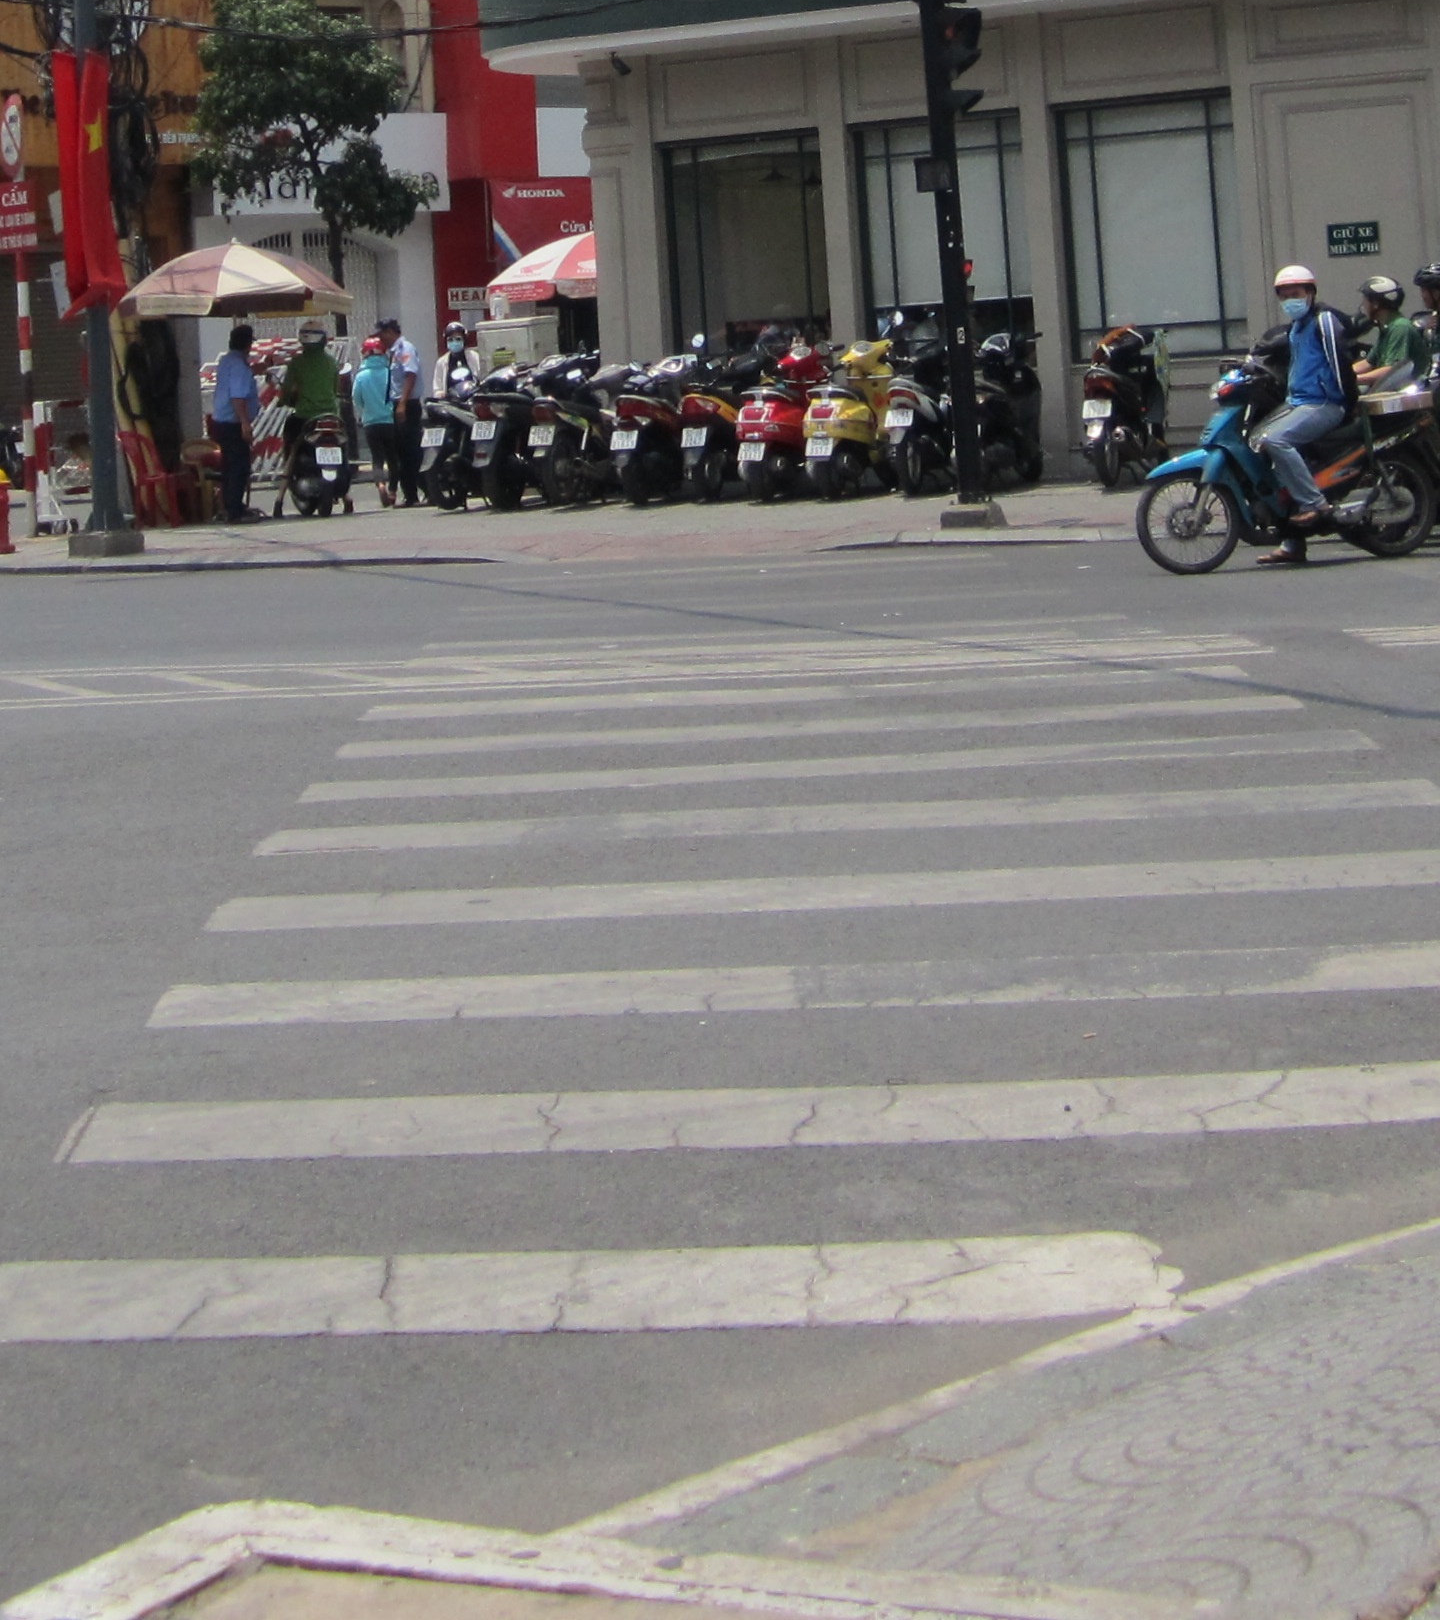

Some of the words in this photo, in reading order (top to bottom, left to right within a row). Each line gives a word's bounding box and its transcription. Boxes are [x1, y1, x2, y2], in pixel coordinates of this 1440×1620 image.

[1, 186, 28, 207] CẤM
[517, 188, 565, 198] HONDA
[560, 220, 586, 233] Cửa
[1332, 225, 1356, 239] GIỮ
[1358, 226, 1375, 237] XE
[450, 290, 486, 301] HEA
